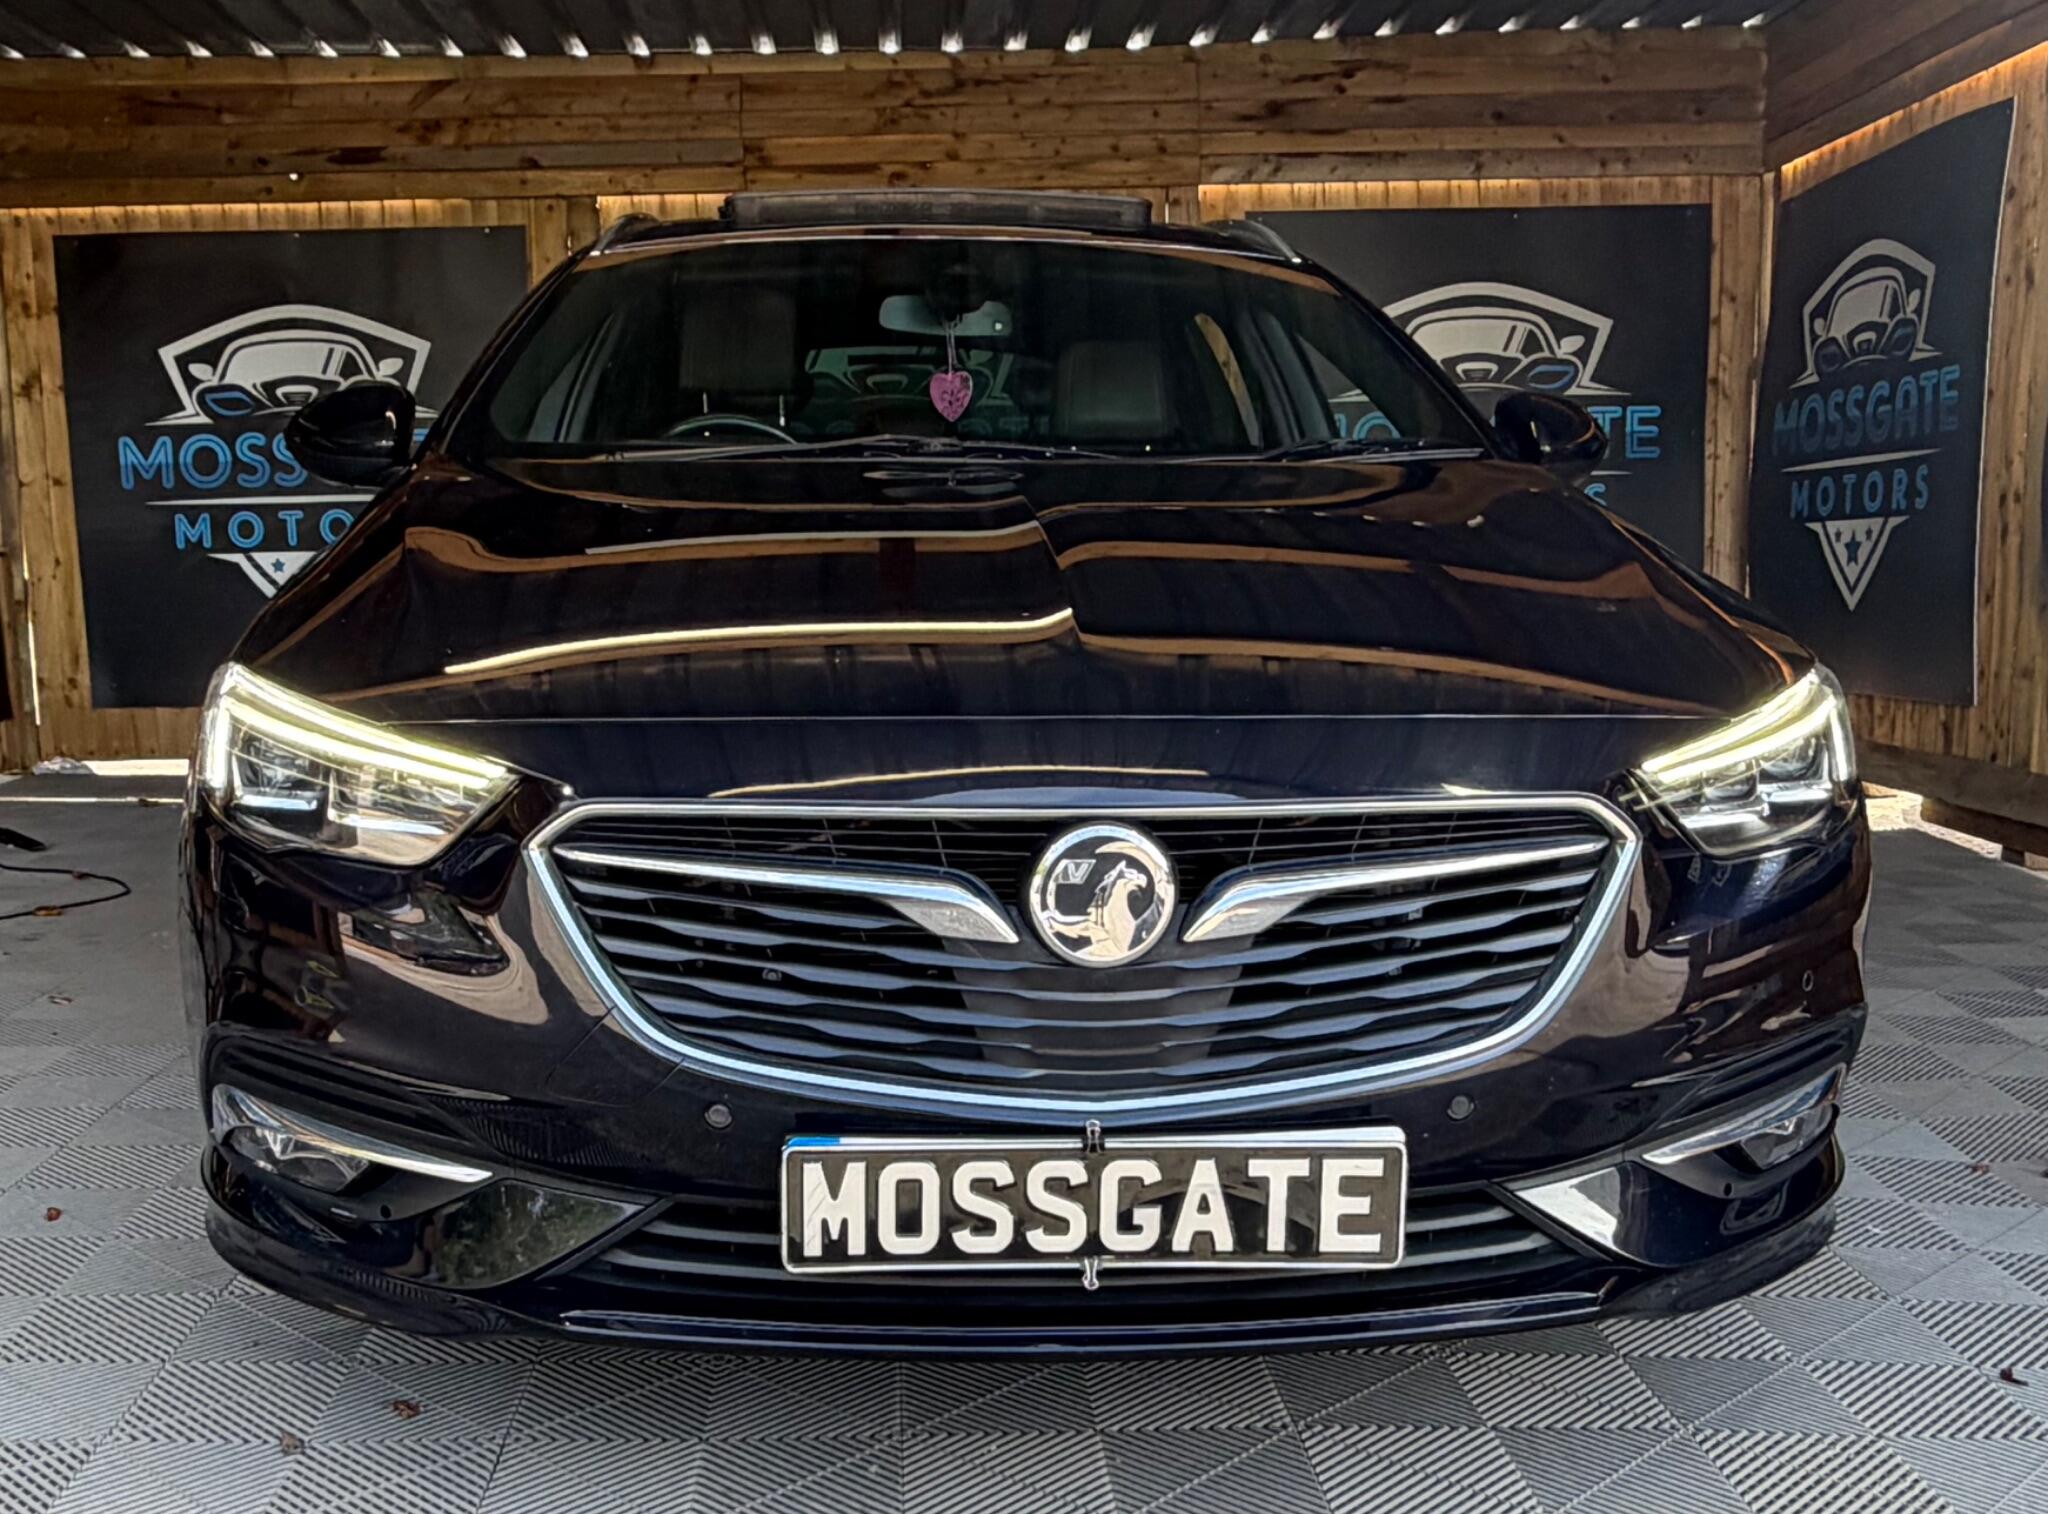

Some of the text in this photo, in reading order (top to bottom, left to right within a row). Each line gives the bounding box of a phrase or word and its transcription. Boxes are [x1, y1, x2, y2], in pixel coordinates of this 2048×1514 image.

[1772, 364, 1961, 456] MOSSGATE
[117, 431, 310, 491] MOSS
[1789, 463, 1930, 520] MOTORS
[173, 508, 354, 550] MOTO
[801, 1156, 1386, 1257] MOSSGATE
